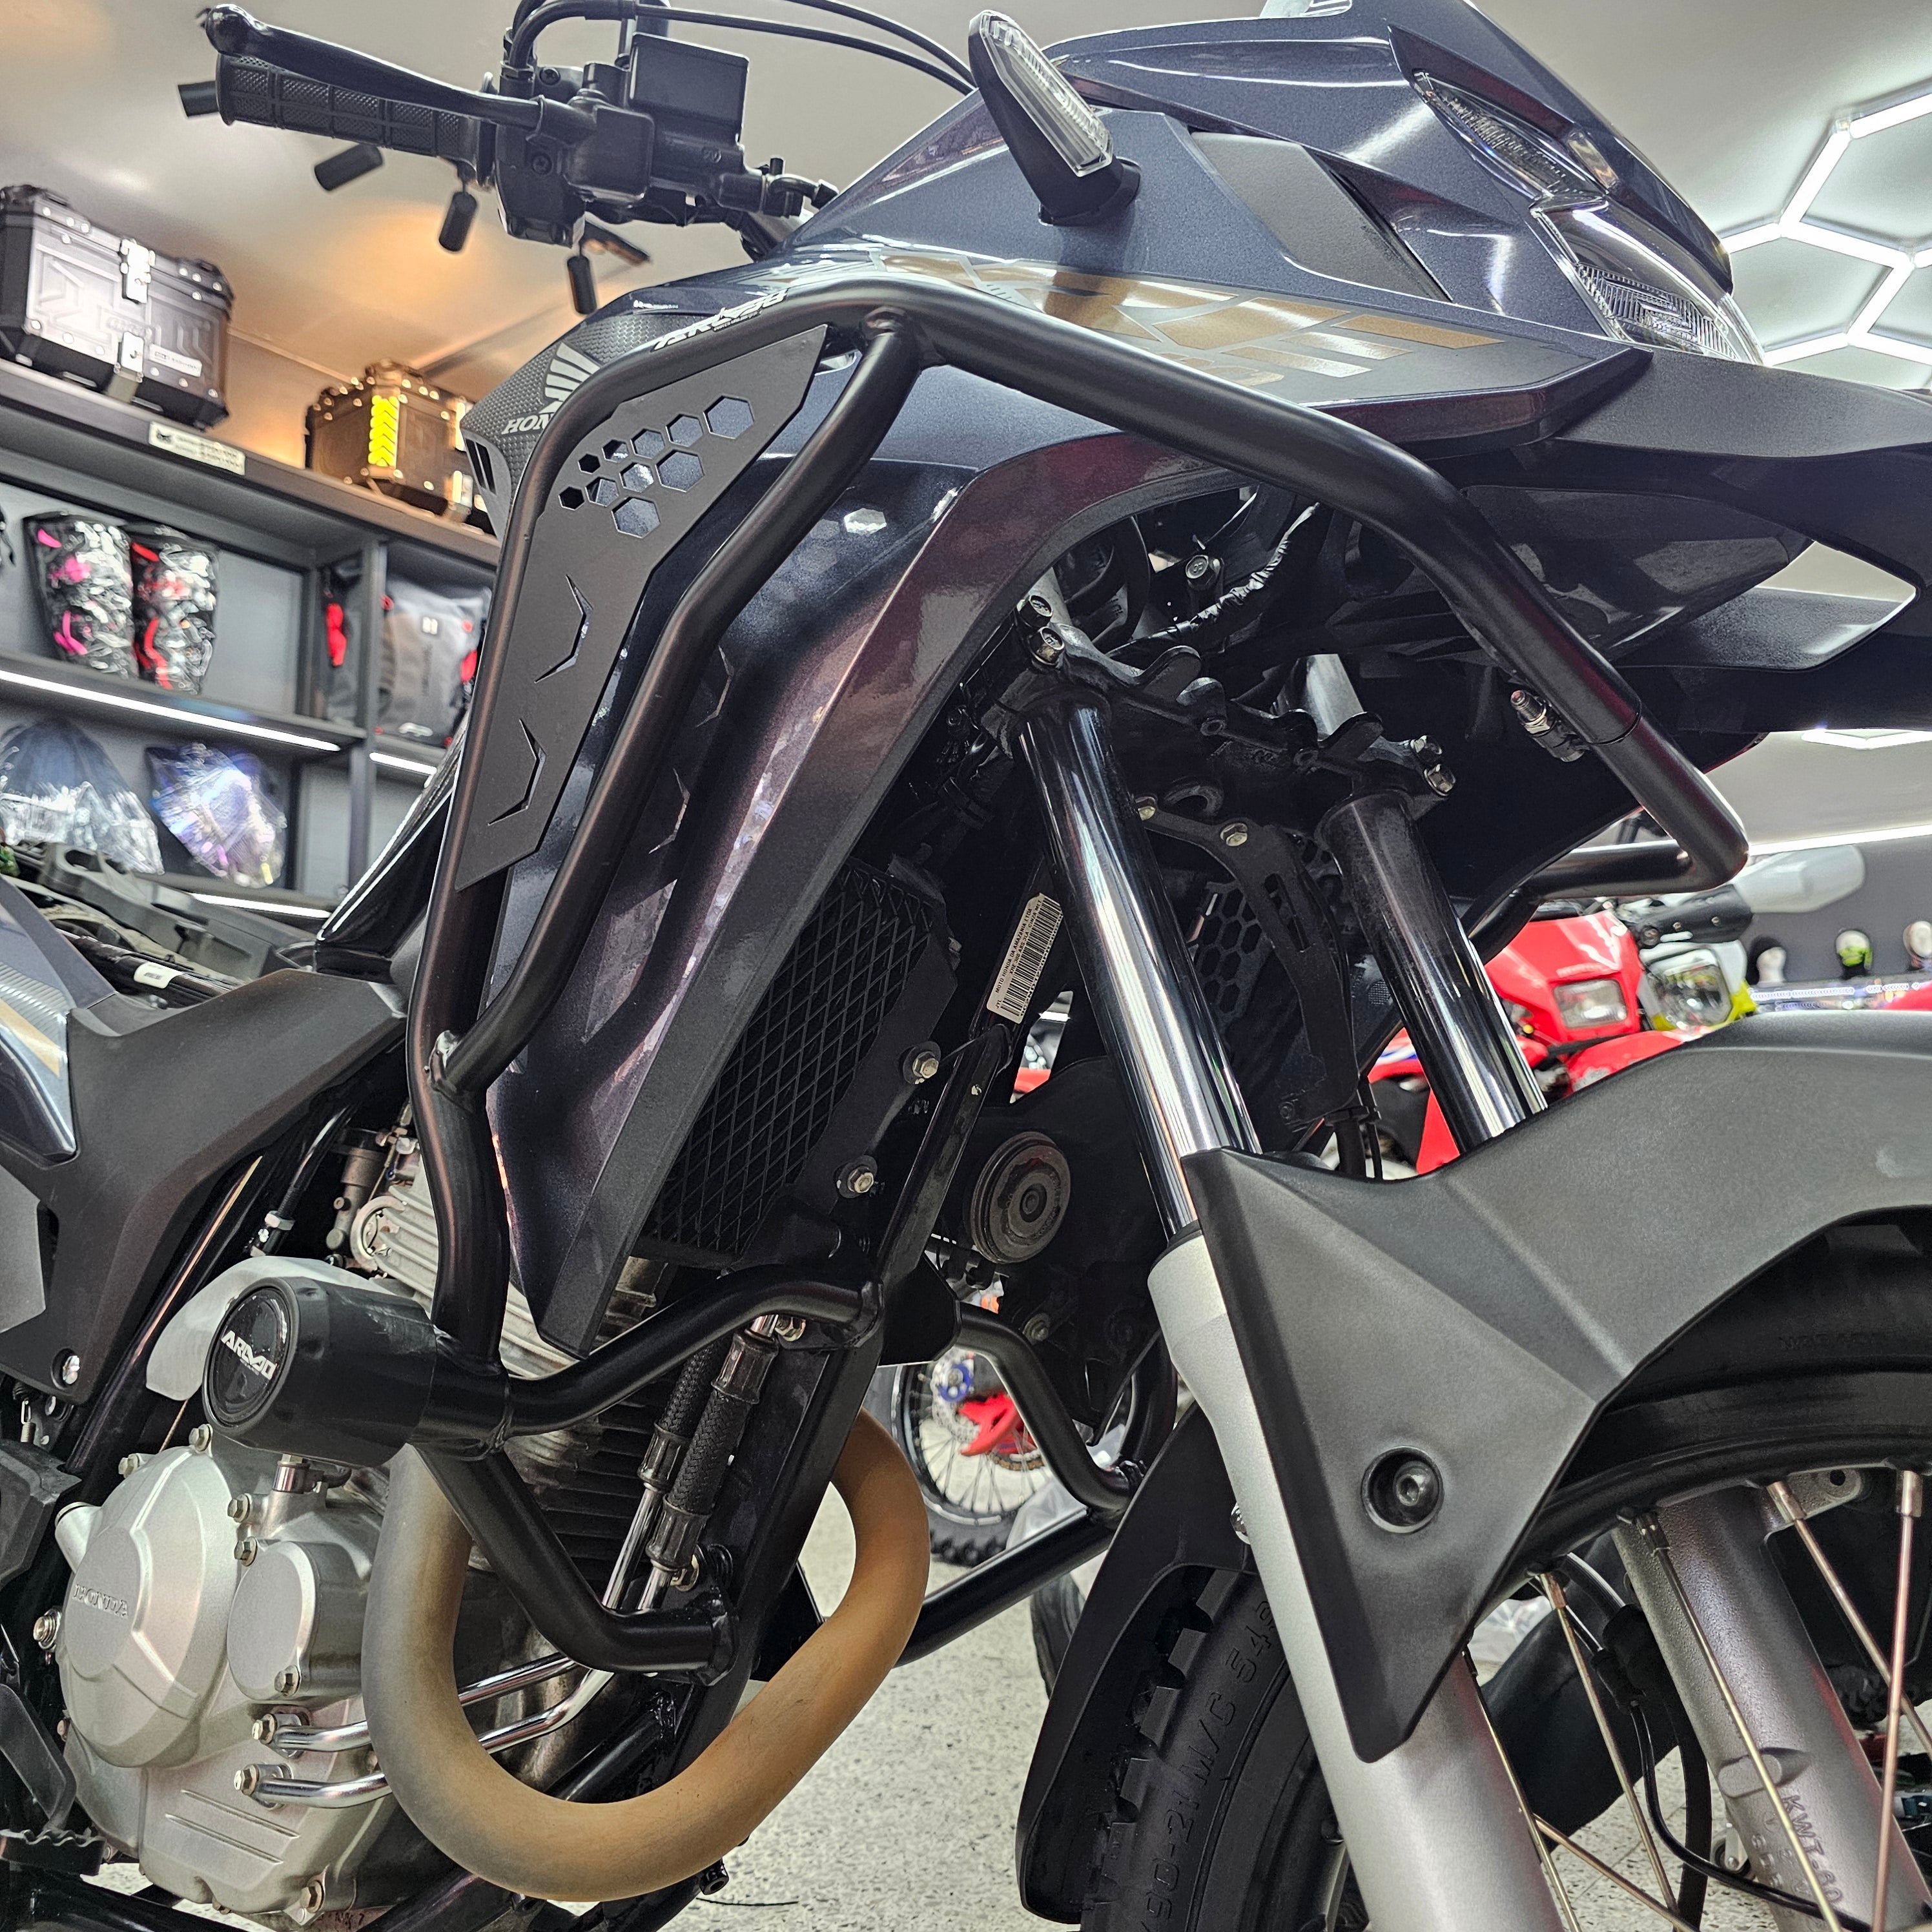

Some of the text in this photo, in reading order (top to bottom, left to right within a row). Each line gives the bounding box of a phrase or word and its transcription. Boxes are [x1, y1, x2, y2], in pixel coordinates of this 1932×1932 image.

[501, 413, 555, 435] HON
[995, 978, 1004, 993] MOTO
[1002, 959, 1012, 978] HONDA
[72, 1584, 129, 1619] HONDA
